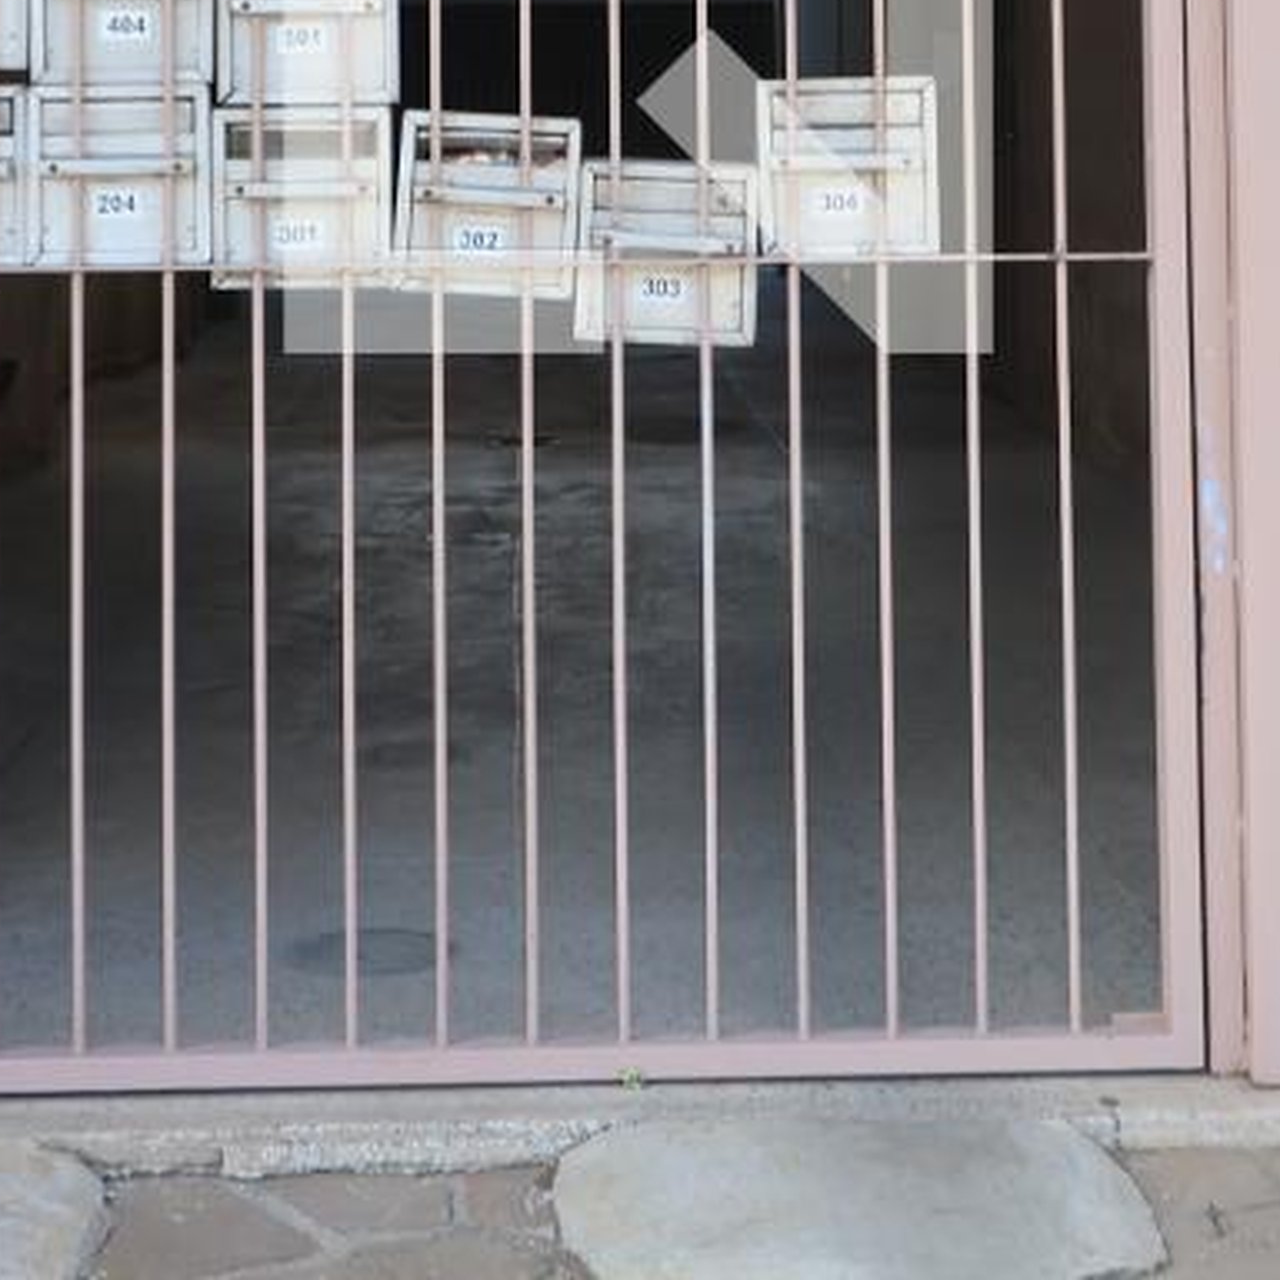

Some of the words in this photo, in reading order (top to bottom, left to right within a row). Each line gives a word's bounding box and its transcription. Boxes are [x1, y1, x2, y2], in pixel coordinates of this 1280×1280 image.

[106, 15, 146, 34] 404
[97, 193, 136, 214] 204
[460, 230, 498, 250] 302
[642, 278, 682, 298] 303
